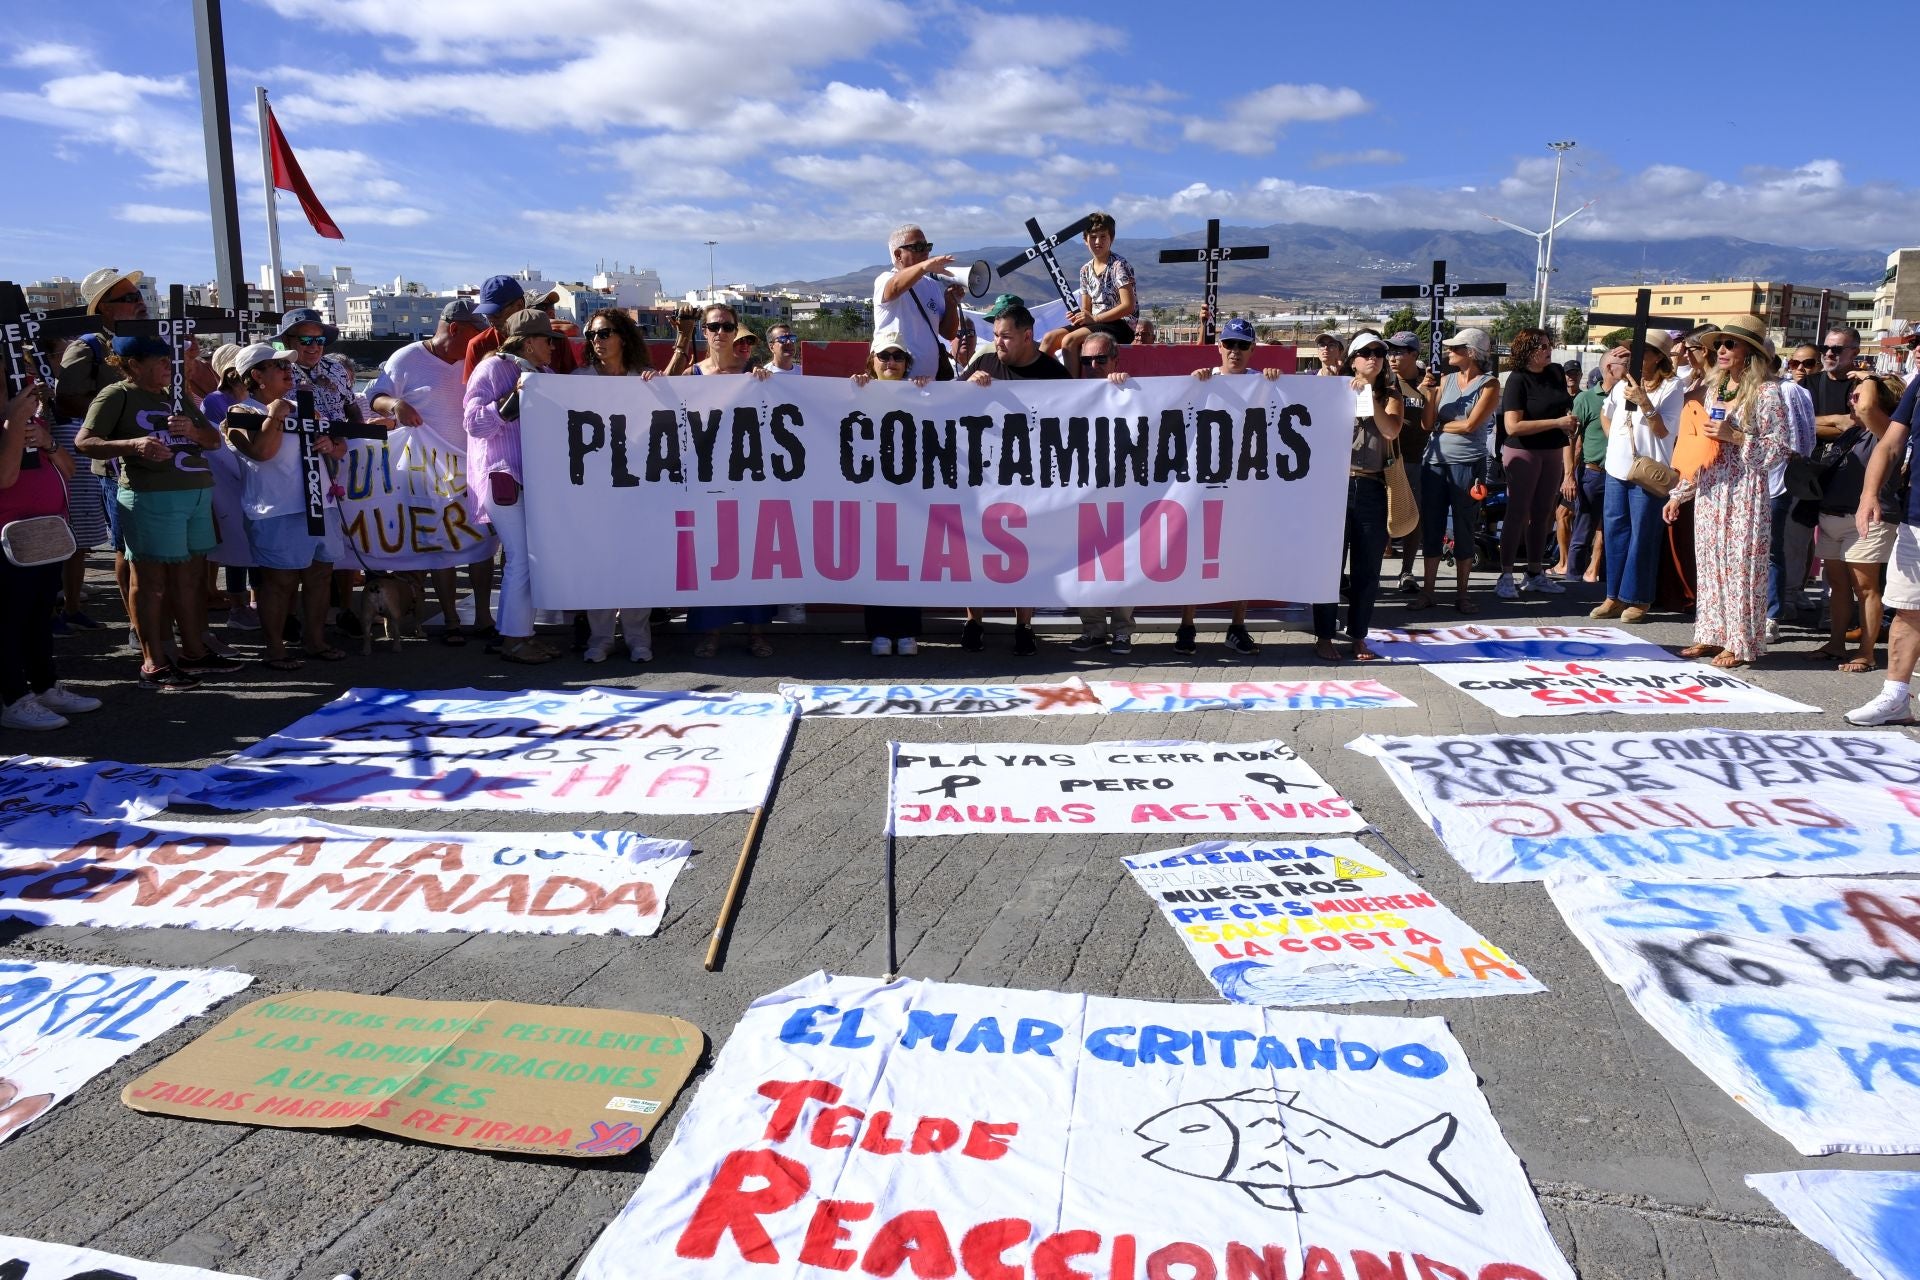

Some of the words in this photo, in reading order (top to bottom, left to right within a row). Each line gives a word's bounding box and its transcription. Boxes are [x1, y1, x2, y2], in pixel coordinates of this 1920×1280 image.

[1044, 252, 1080, 312] LITORAL
[1206, 260, 1218, 336] LITORAL
[0, 322, 40, 343] .E.P.
[1431, 297, 1444, 374] LITORAL
[170, 334, 185, 414] LITORA
[567, 403, 804, 488] PLAYAS
[839, 402, 1312, 490] CONTAMINADAS
[304, 433, 323, 519] LITORAL
[342, 501, 484, 554] MUER
[674, 499, 1029, 592] ¡JAULAS
[1077, 499, 1225, 583] NO!
[1525, 662, 1603, 676] LA
[800, 698, 1034, 716] LIMPIAS
[812, 686, 1018, 701] PLAYAS
[1110, 680, 1402, 700] PLAYAS
[1530, 686, 1730, 707] SIGUE
[896, 753, 1076, 769] PLAYAS
[1108, 743, 1298, 764] CERRADAS
[1612, 735, 1888, 762] CANARIA
[294, 763, 711, 803] LUCHA
[1059, 777, 1175, 793] PERO
[1427, 767, 1557, 800] NO
[1561, 760, 1677, 797] SE
[1674, 757, 1920, 792] VEND
[900, 803, 1096, 824] JAULAS
[1131, 795, 1352, 824] ACTIVAS
[1456, 796, 1848, 838] JAULAS
[50, 831, 231, 865] NO
[243, 836, 326, 866] A
[343, 836, 464, 870] LA
[1135, 865, 1270, 888] PLAYA
[1268, 861, 1324, 877] EN
[1161, 879, 1364, 903] NUESTROS
[1171, 901, 1313, 924] PECES
[1310, 892, 1437, 914] MUEREN
[1604, 880, 1845, 933] SIN
[1185, 912, 1410, 943] SALVEMOS
[1214, 942, 1274, 960] LA
[1278, 928, 1442, 953] COSTA
[255, 1003, 388, 1029] NUESTRAS
[396, 1016, 493, 1034] PLAYAS
[502, 1023, 690, 1056] PESTILENTES
[779, 1004, 876, 1050] EL
[898, 1011, 1064, 1057] MAR
[1085, 1025, 1450, 1080] GRITANDO
[214, 1027, 256, 1042] Y
[252, 1032, 325, 1053] LAS
[324, 1041, 662, 1089] ADMINISTRACIONES
[254, 1066, 497, 1110] AUSENTES
[131, 1081, 254, 1111] JAULAS
[254, 1096, 401, 1118] MARINAS
[400, 1108, 574, 1147] RETIRADA
[575, 1120, 642, 1152] YA
[757, 1079, 1019, 1161] TELDE
